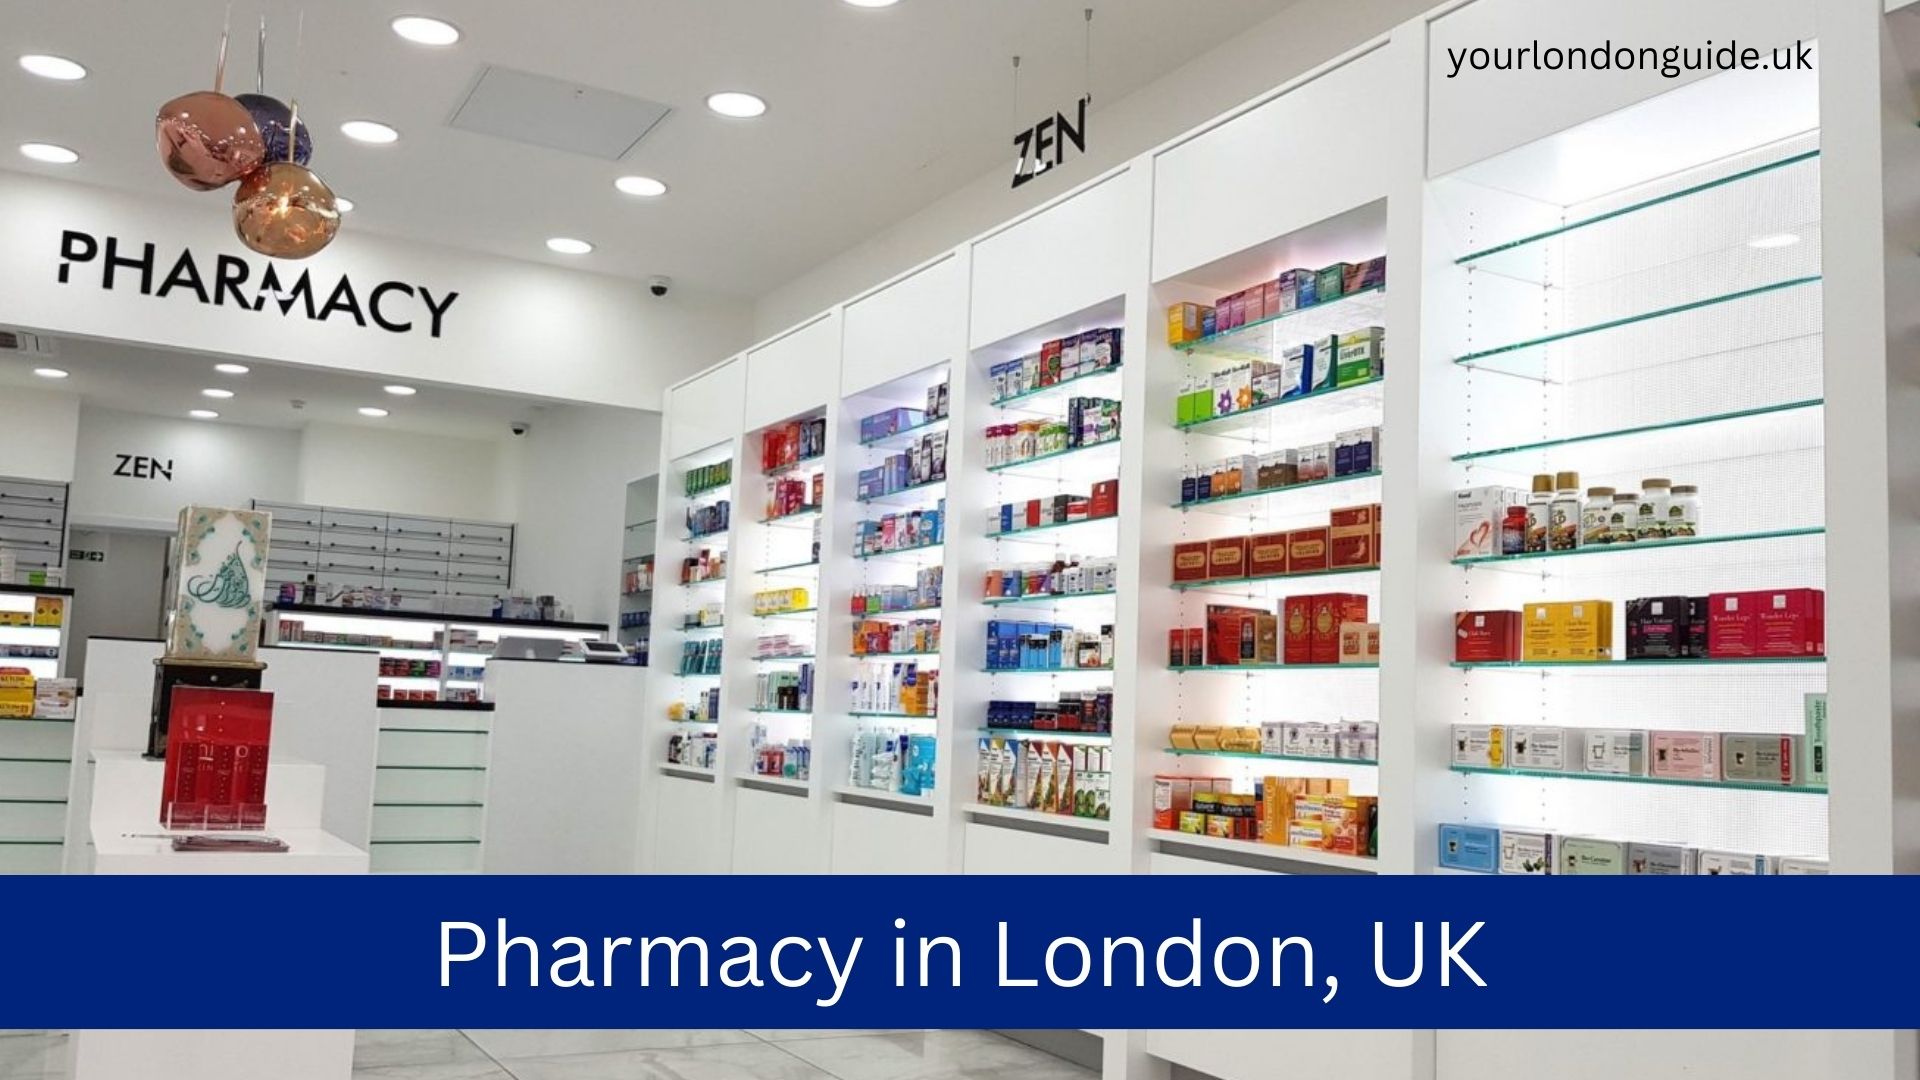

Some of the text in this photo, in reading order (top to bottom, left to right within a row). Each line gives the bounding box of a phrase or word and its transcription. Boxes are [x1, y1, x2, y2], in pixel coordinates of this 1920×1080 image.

[1011, 98, 1086, 189] ZEN
[58, 230, 459, 338] PHARMACY
[113, 453, 174, 482] ZEN
